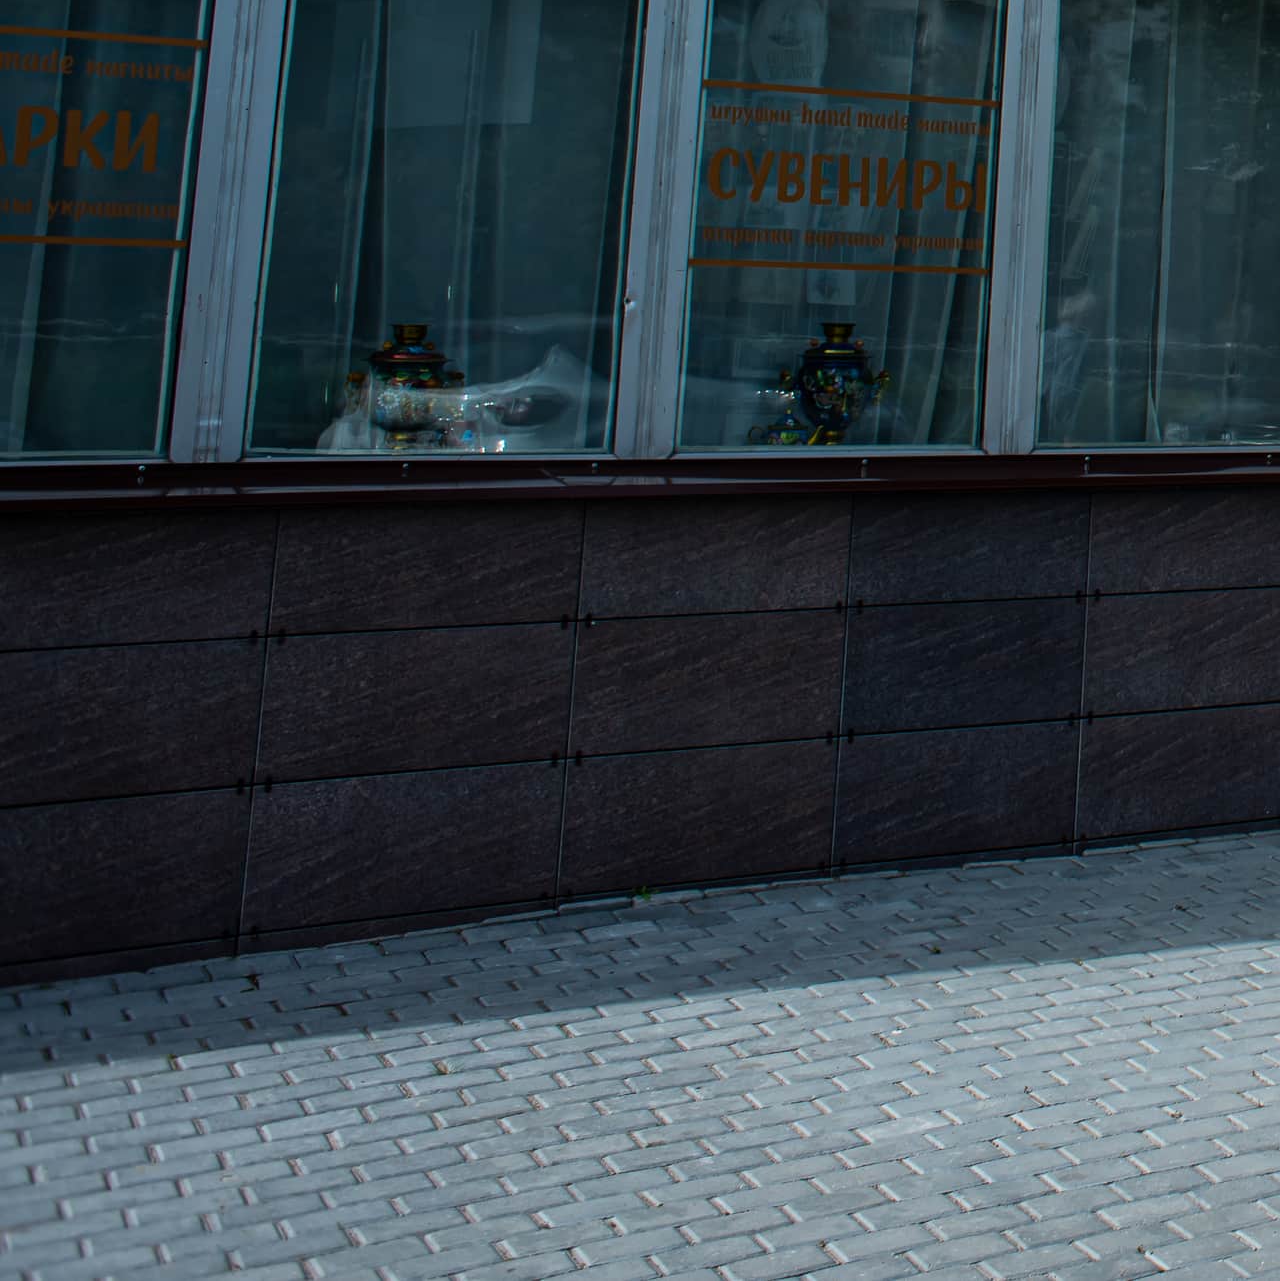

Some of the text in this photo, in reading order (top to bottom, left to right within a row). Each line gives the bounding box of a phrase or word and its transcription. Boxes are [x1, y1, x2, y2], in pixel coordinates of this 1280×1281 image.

[85, 59, 193, 81] магниты
[0, 105, 160, 173] РКИ
[711, 102, 990, 136] игрушки hand made магниты
[708, 146, 988, 213] СУВЕНИРЫ
